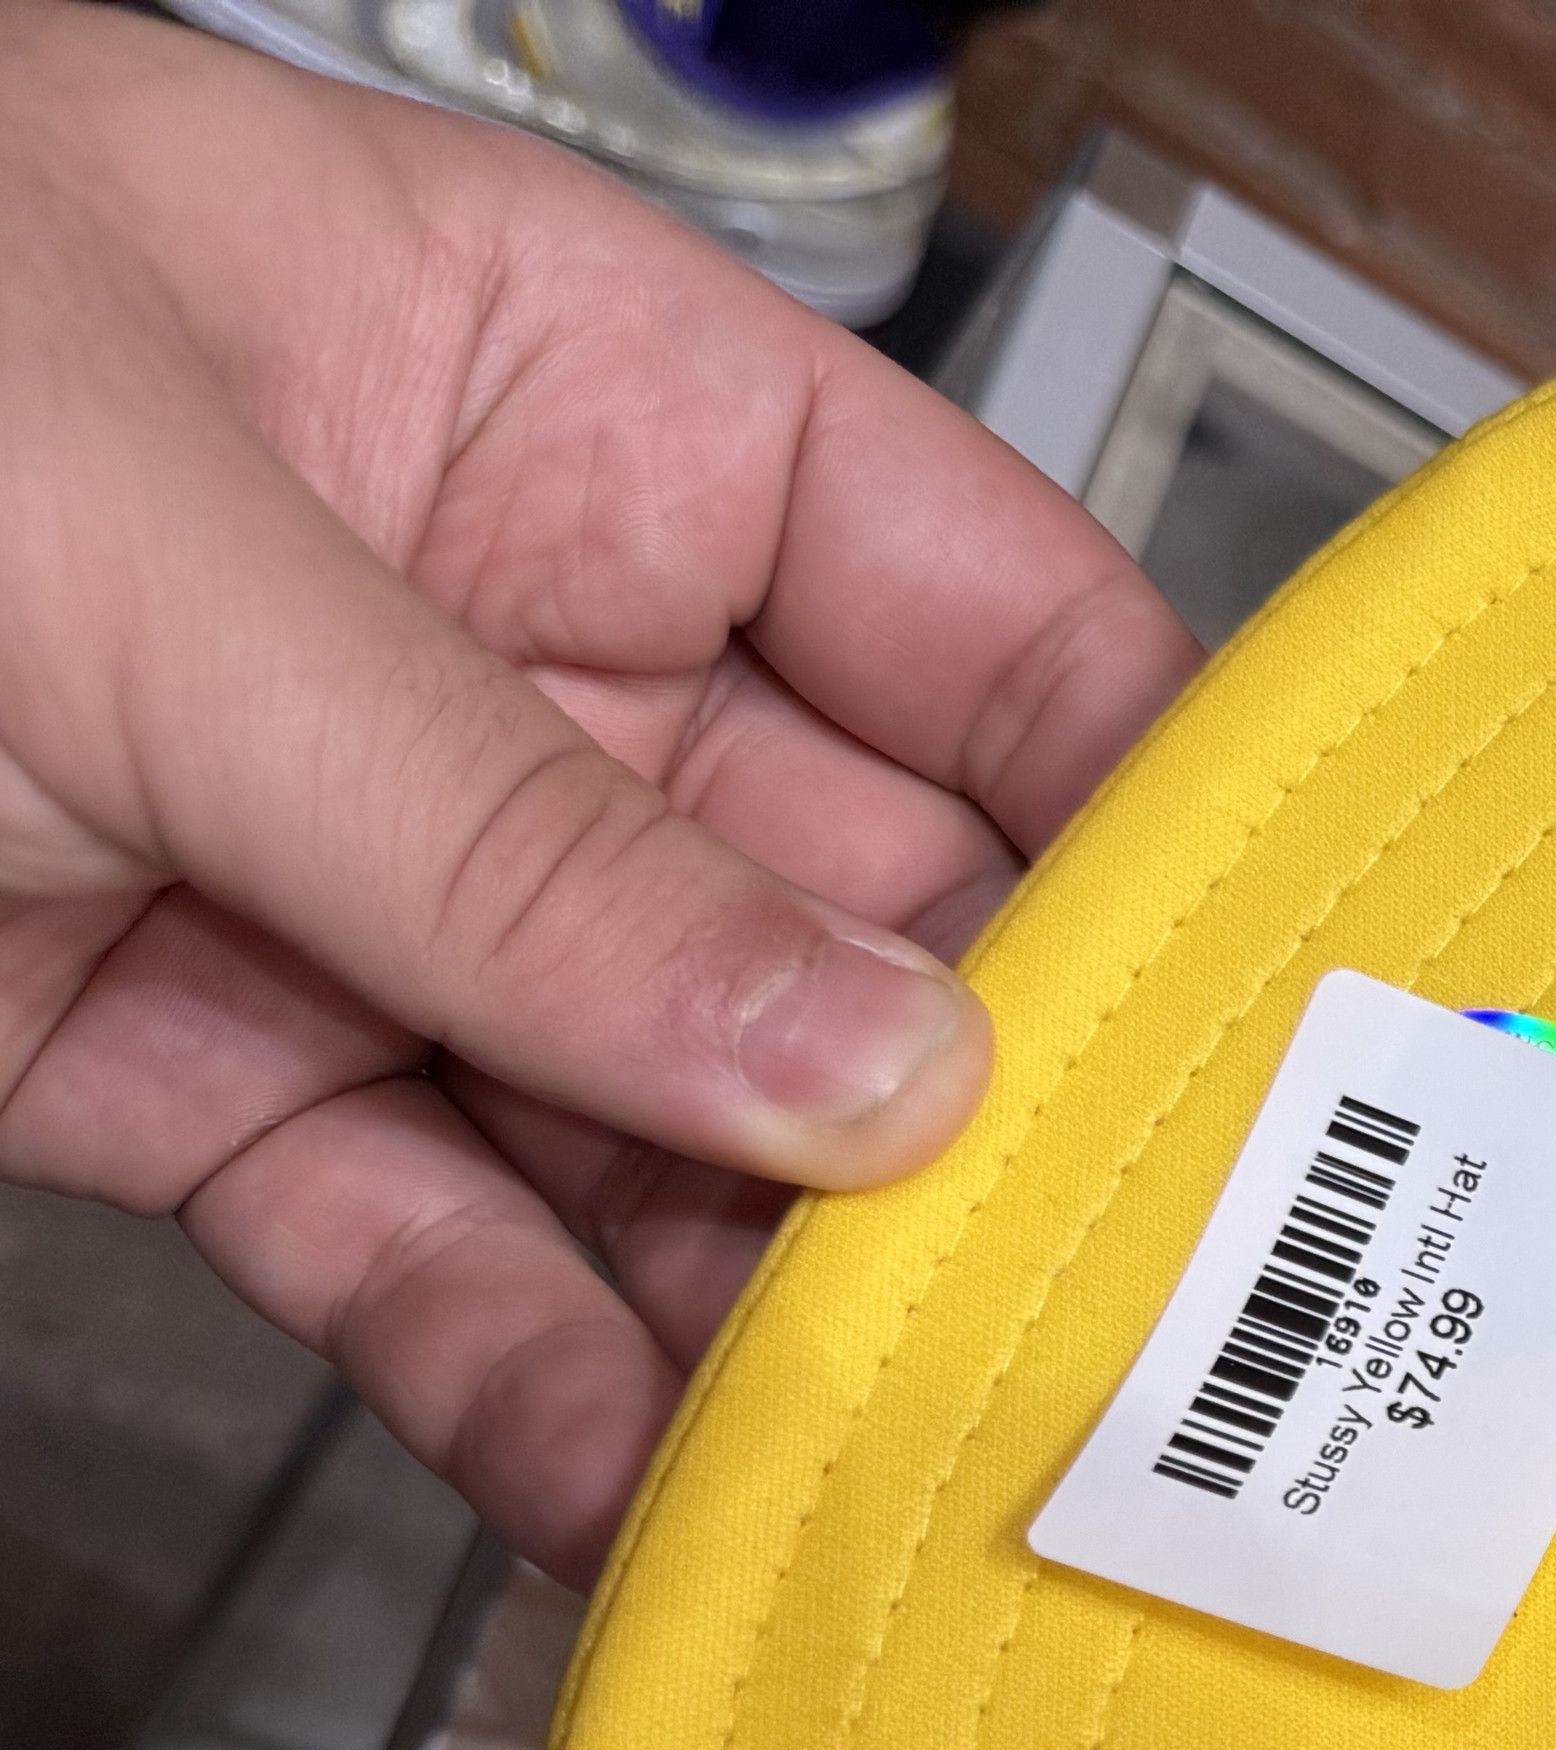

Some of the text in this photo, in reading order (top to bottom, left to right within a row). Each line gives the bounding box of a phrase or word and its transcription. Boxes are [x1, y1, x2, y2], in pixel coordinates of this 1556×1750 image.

[1284, 1154, 1487, 1514] Stussy Yellow Intl Hat
[1316, 1278, 1380, 1367] 16910
[1387, 1289, 1484, 1428] $74.99
